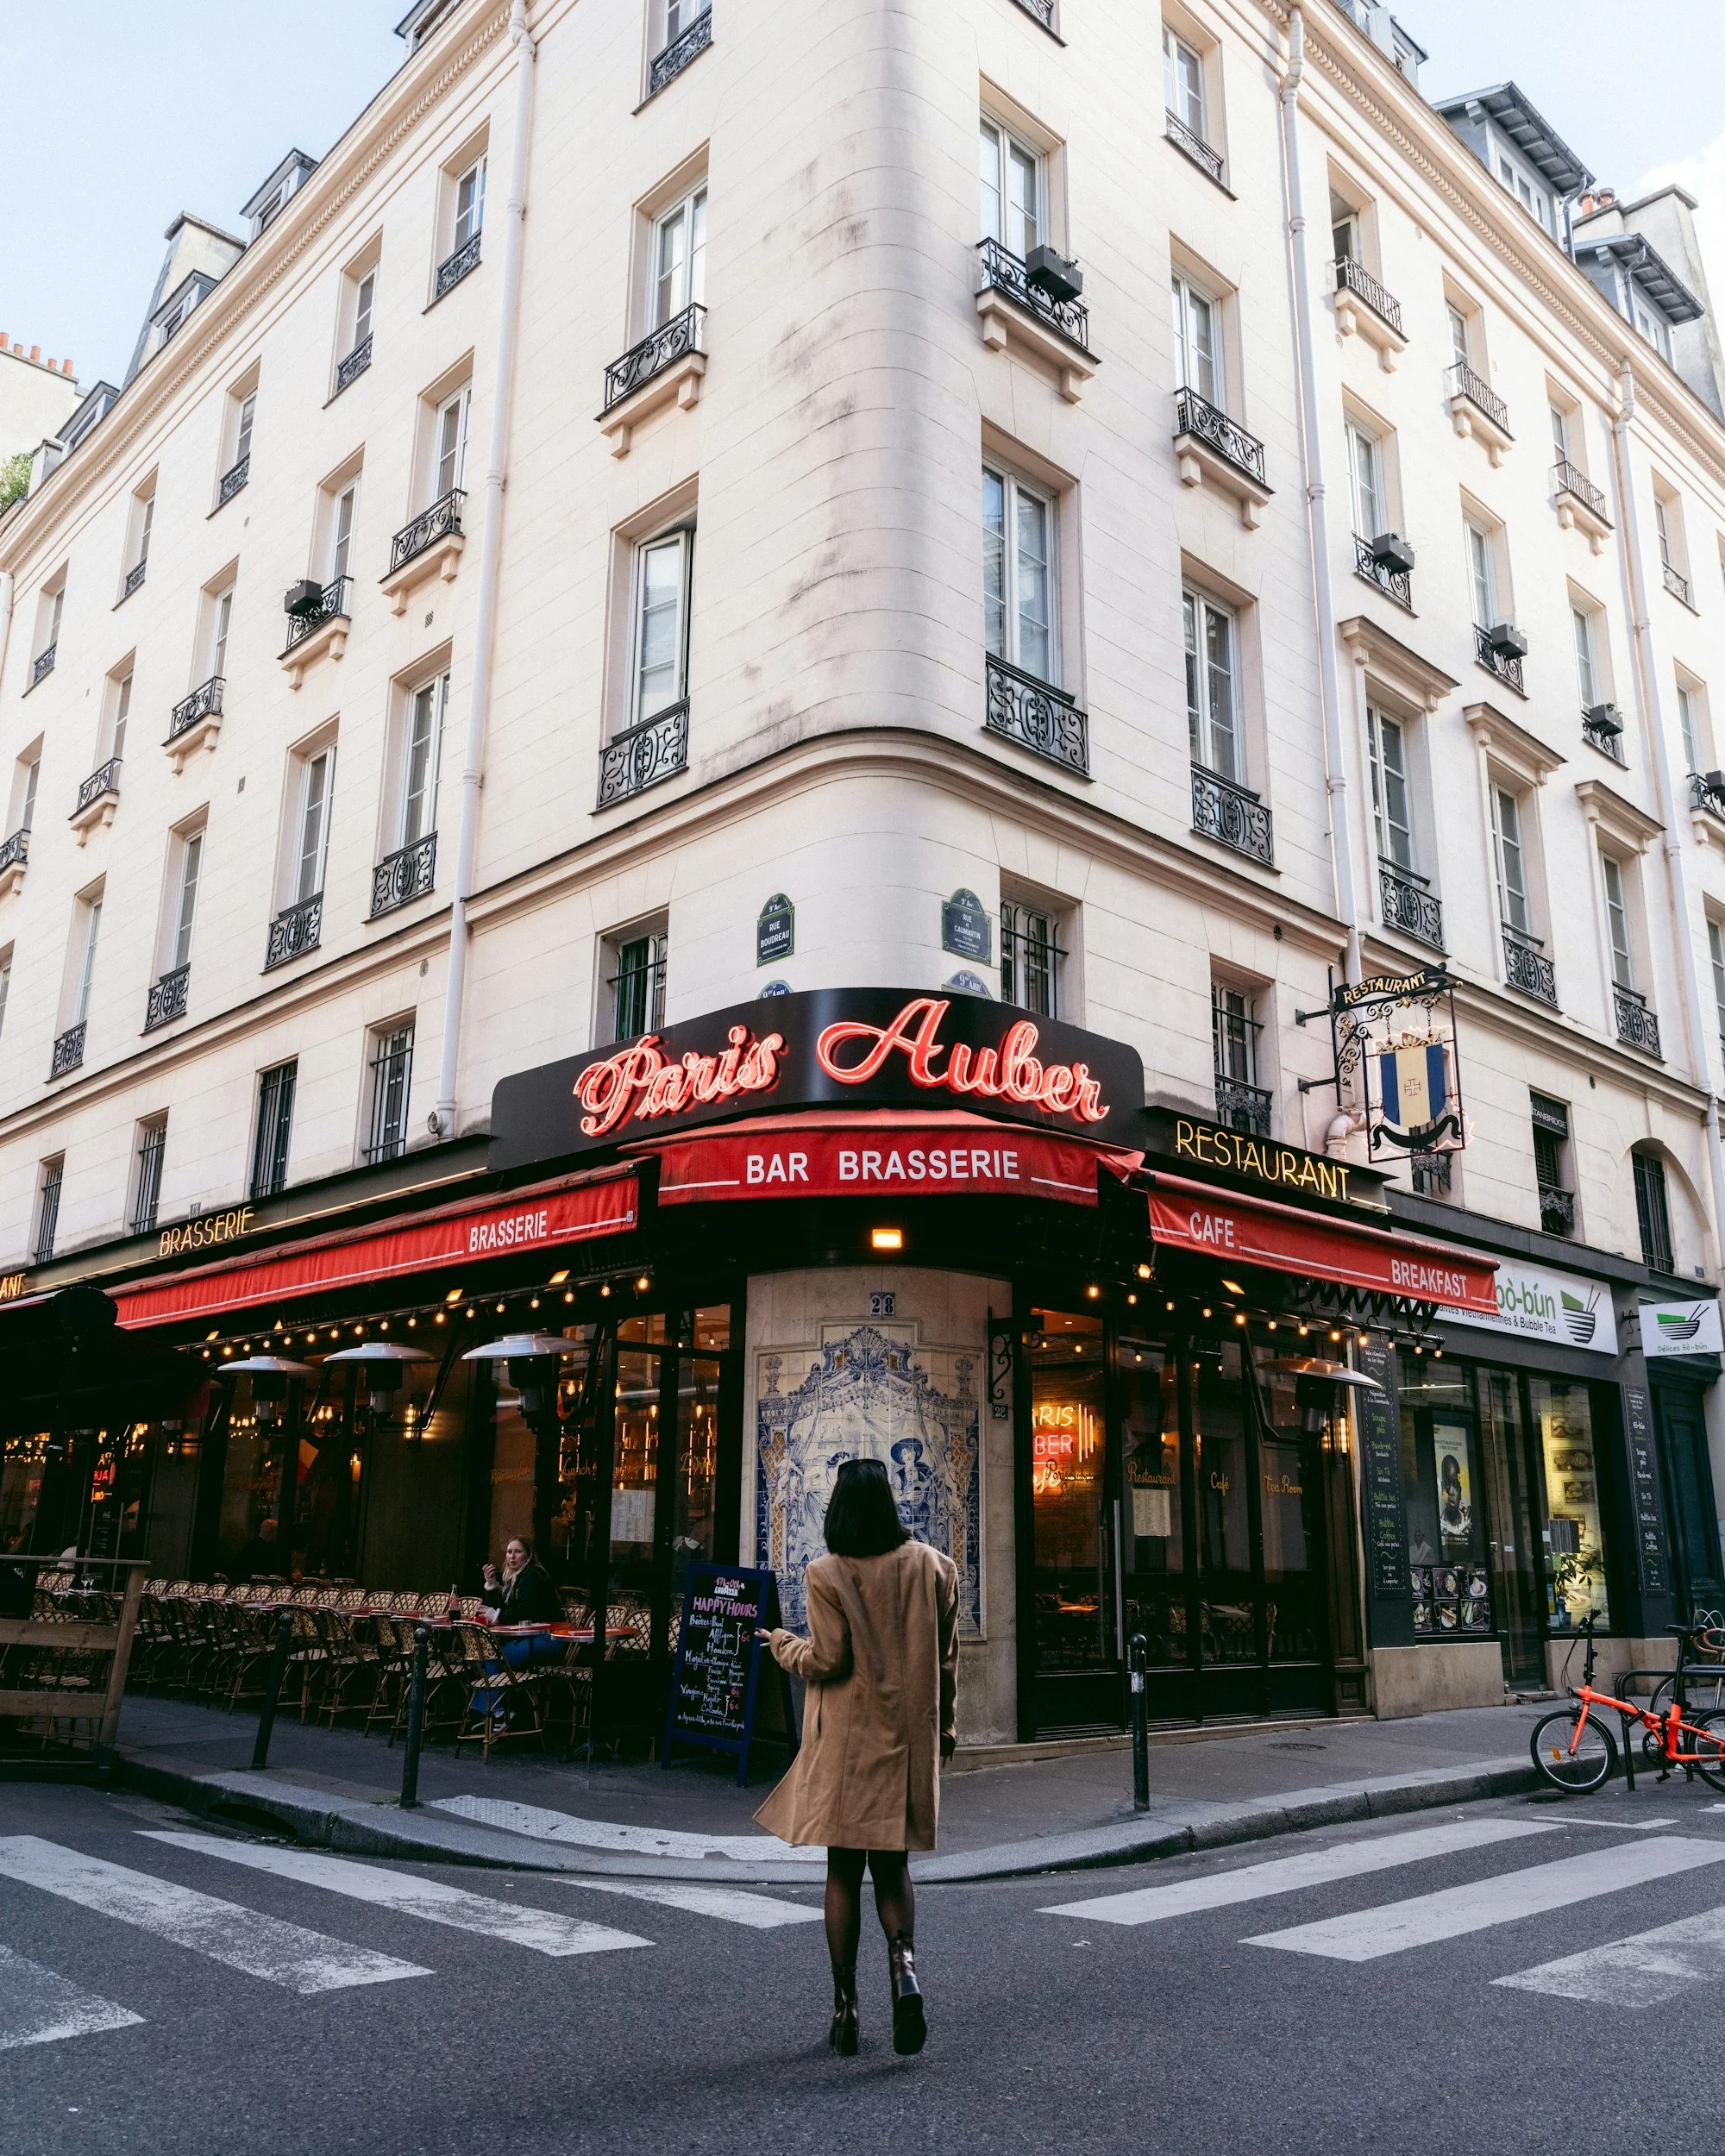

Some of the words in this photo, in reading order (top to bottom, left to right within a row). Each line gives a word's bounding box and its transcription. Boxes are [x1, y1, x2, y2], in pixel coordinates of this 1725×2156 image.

[769, 920, 781, 932] RUE
[963, 914, 972, 923] RUE
[760, 930, 789, 949] BOUDREAU
[954, 924, 981, 940] CAUMARTIN
[1343, 971, 1426, 1005] RESTAURANT
[573, 1025, 786, 1138] Paris
[816, 998, 1111, 1123] Auber
[1532, 1107, 1567, 1130] TANBRIDGE
[747, 1152, 810, 1184] BAR
[839, 1150, 1020, 1181] BRASSERIE
[1176, 1119, 1350, 1200] RESTAURANT
[159, 1206, 254, 1257] BRASSERIE
[469, 1210, 548, 1252] BRASSERIE
[1189, 1211, 1235, 1248] CAFE
[1390, 1258, 1467, 1299] BREAKFAST
[871, 1297, 894, 1313] 28
[1514, 1319, 1519, 1327] &
[1520, 1317, 1543, 1332] Bubble
[1545, 1321, 1556, 1334] Tea
[994, 1406, 1007, 1419] 28
[1127, 1461, 1176, 1486] Restaurant
[1210, 1470, 1229, 1497] Café
[1263, 1474, 1281, 1493] Tea
[1281, 1474, 1303, 1495] Room
[1379, 1529, 1396, 1541] Coffee
[714, 1586, 738, 1597] LAVAZZA
[693, 1596, 727, 1614] HAPPY
[726, 1601, 758, 1619] HOURS
